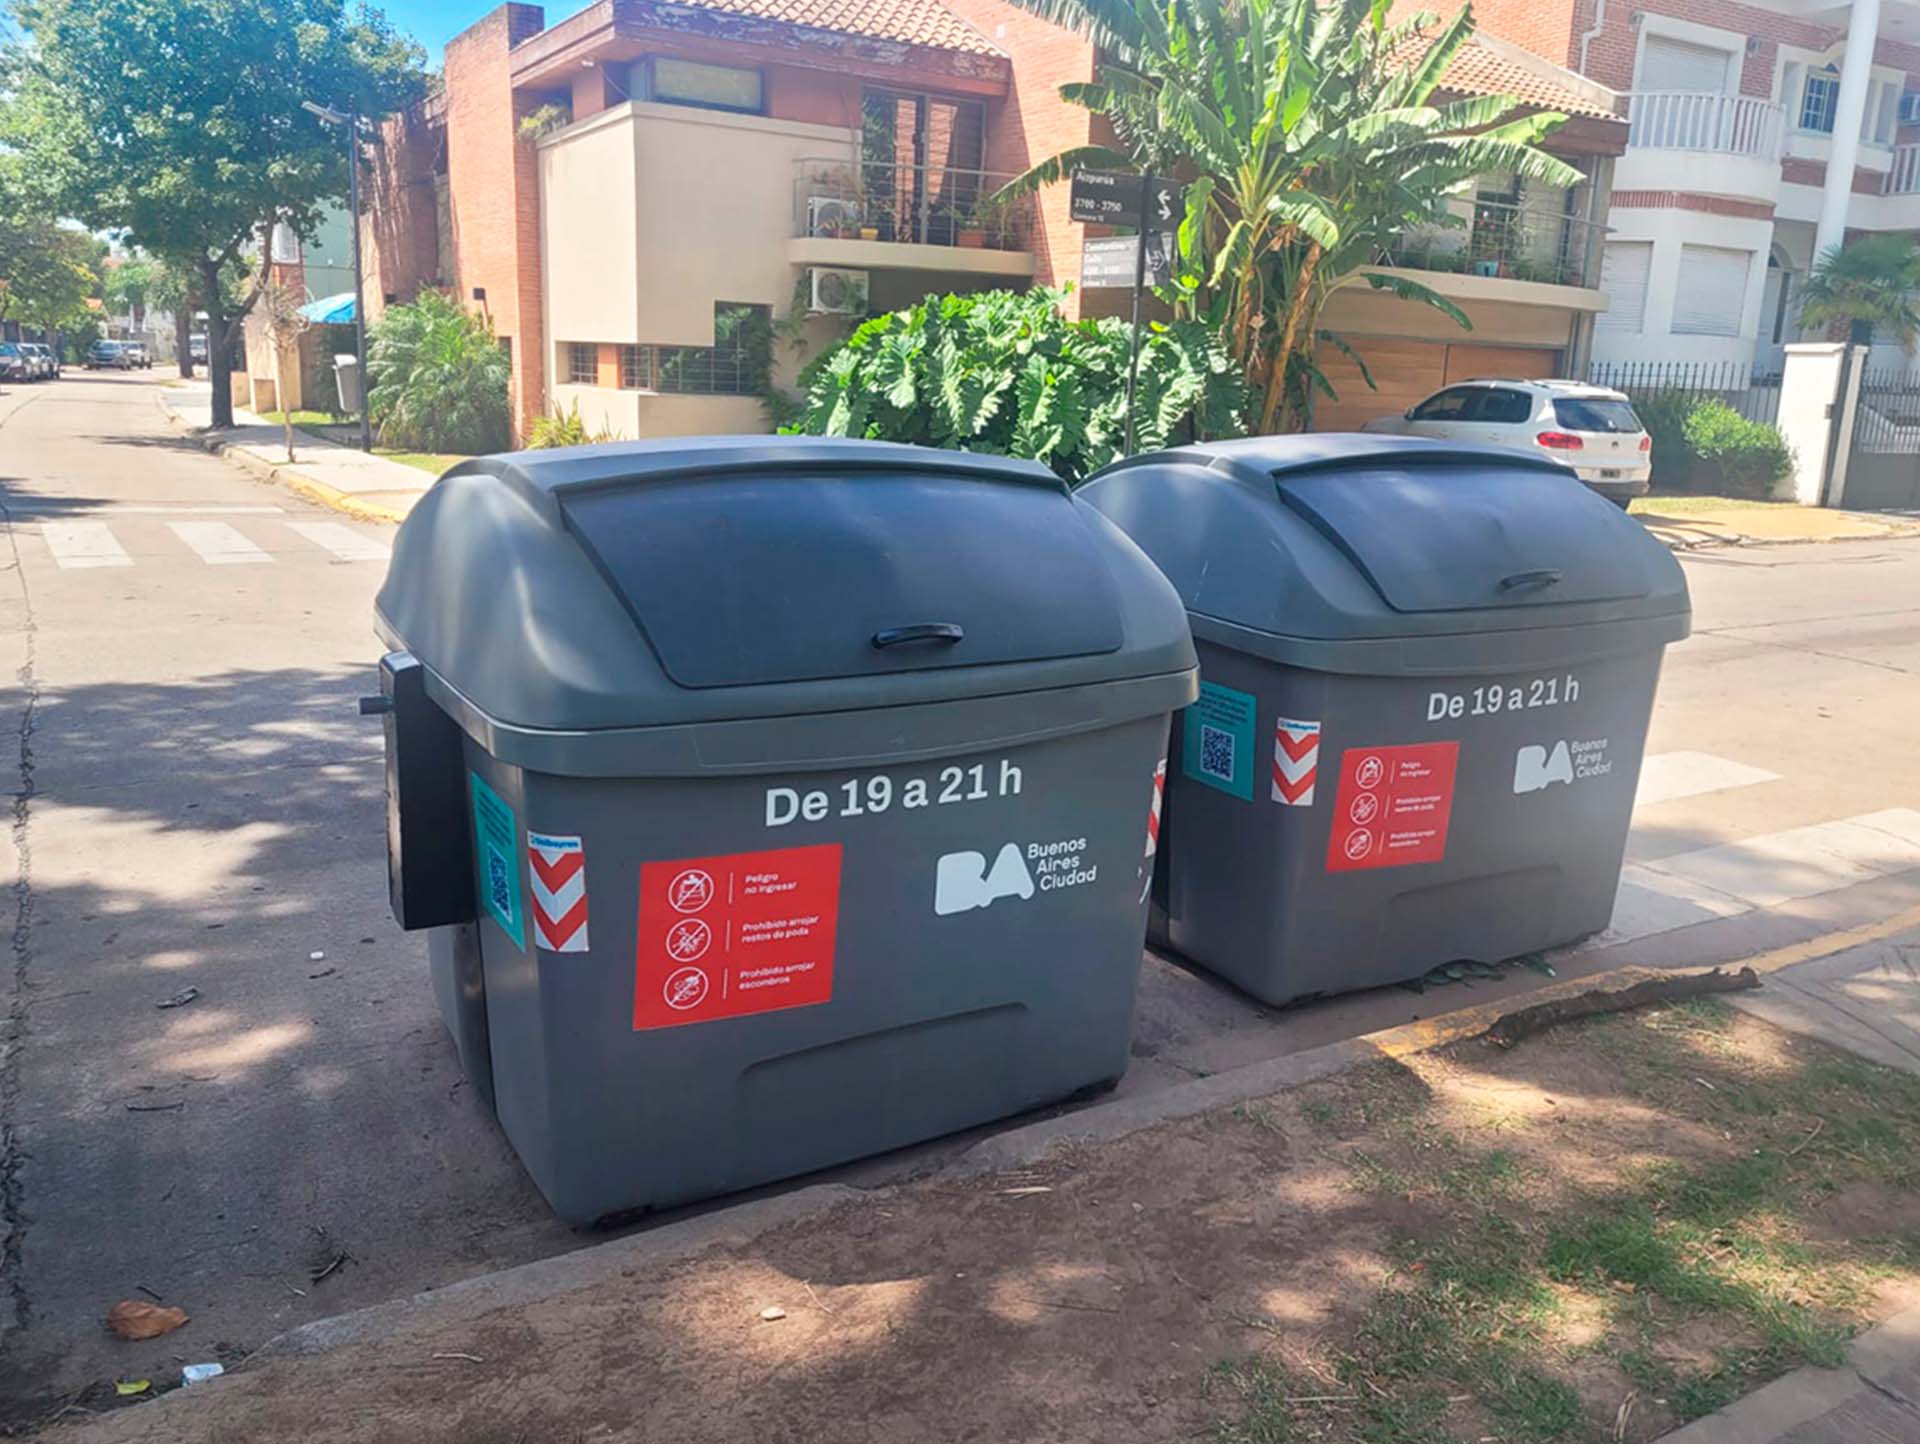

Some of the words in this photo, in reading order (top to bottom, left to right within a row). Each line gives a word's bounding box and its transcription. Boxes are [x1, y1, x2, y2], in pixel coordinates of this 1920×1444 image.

[1427, 692, 1465, 721] De
[1471, 685, 1503, 715] 19
[1508, 687, 1524, 711] a
[1528, 678, 1558, 708] 21
[1564, 674, 1581, 702] h
[1571, 738, 1608, 754] Buenos
[1575, 751, 1604, 766] Aires
[1576, 761, 1612, 779] Ciudad
[765, 786, 828, 827] De
[839, 774, 892, 817] 19
[902, 777, 929, 808] a
[938, 763, 988, 804] 21
[1000, 759, 1023, 796] h
[1027, 836, 1087, 860] Buenos
[1035, 854, 1081, 876] Aires
[745, 873, 779, 884] Peligro
[1039, 866, 1097, 892] Ciudad
